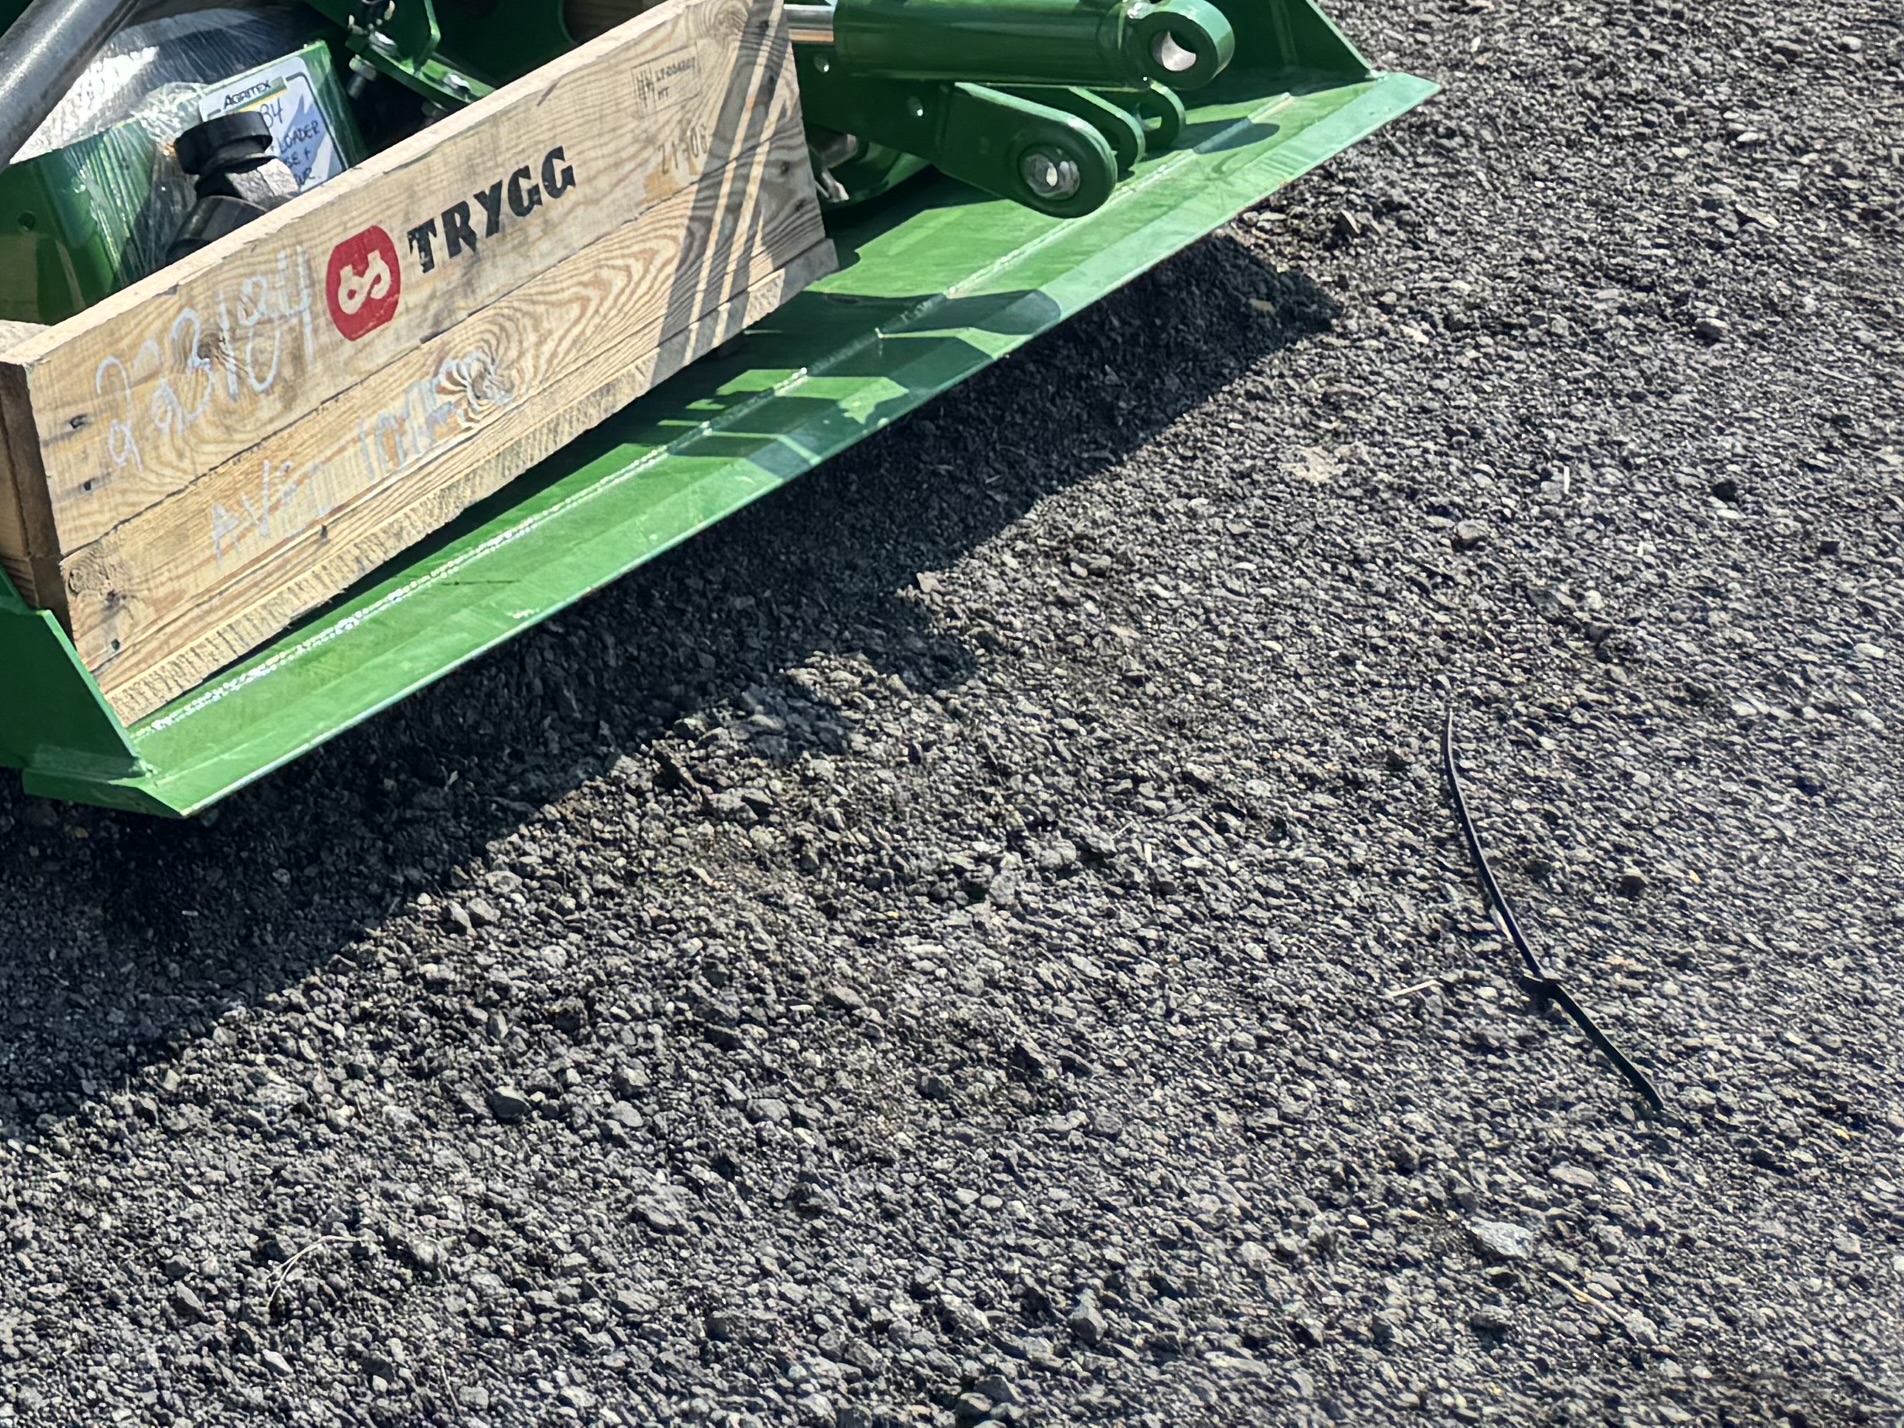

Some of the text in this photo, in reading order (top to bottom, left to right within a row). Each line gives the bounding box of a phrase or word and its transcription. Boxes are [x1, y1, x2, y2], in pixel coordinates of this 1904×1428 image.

[223, 79, 272, 109] AGRITEX
[277, 119, 321, 155] LOADER
[406, 145, 577, 274] TRYGG
